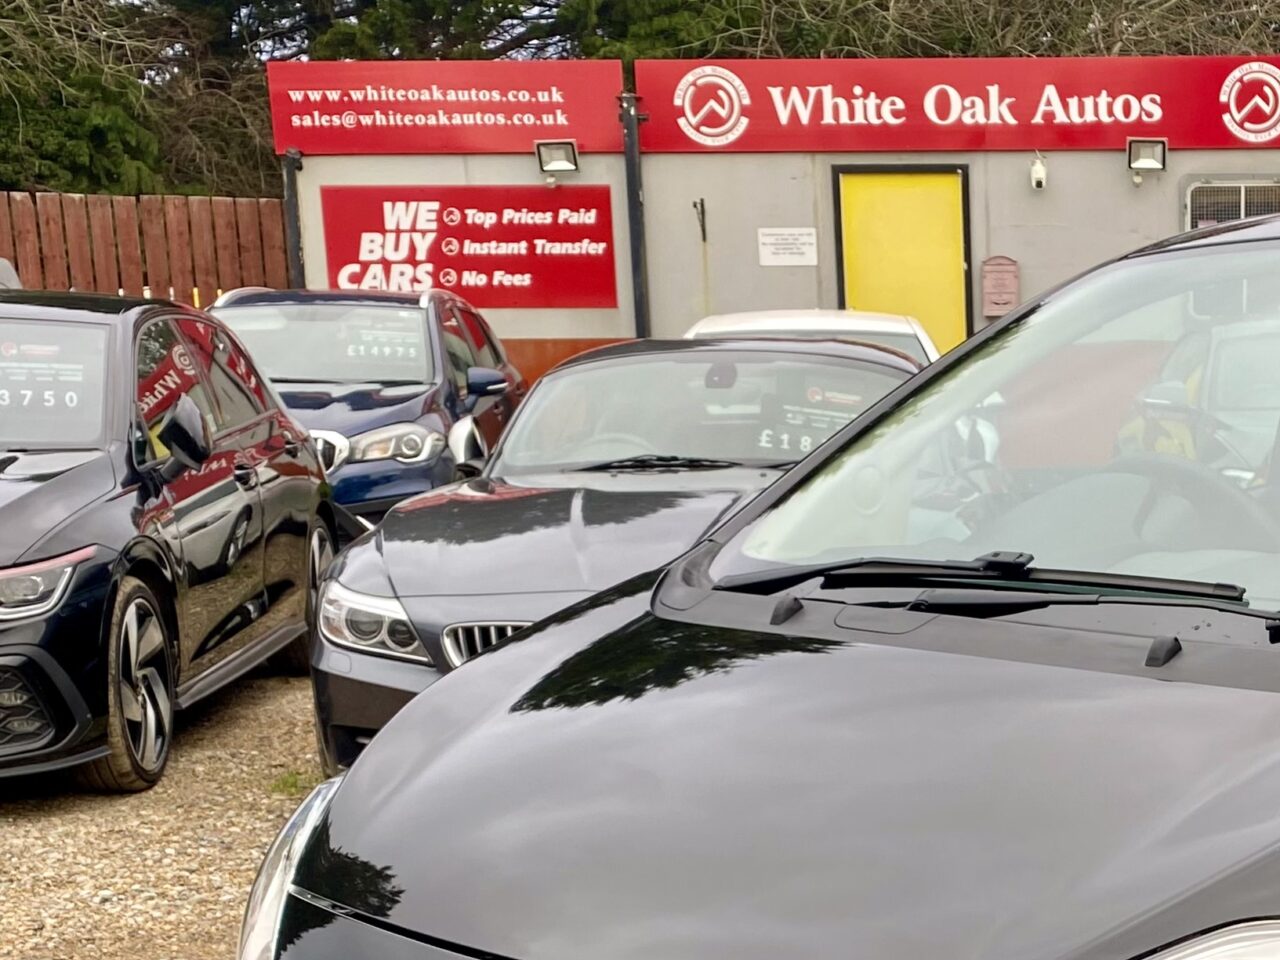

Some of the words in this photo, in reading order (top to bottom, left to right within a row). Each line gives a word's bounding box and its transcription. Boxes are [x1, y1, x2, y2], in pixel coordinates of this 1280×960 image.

[288, 85, 565, 103] www.whiteoakautos.co.uk
[767, 84, 906, 125] White
[923, 84, 1018, 125] Oak
[1031, 84, 1163, 125] Autos
[291, 109, 569, 128] sales@whiteoakautos.co.uk
[383, 201, 440, 230] WE
[464, 209, 497, 228] Top
[502, 209, 552, 225] Prices
[558, 209, 597, 225] Paid
[359, 232, 437, 261] BUY
[463, 240, 528, 255] Instant
[534, 239, 607, 255] Transfer
[337, 263, 434, 291] CARS
[461, 271, 488, 287] No
[492, 271, 532, 287] Fees
[759, 429, 826, 452] £18
